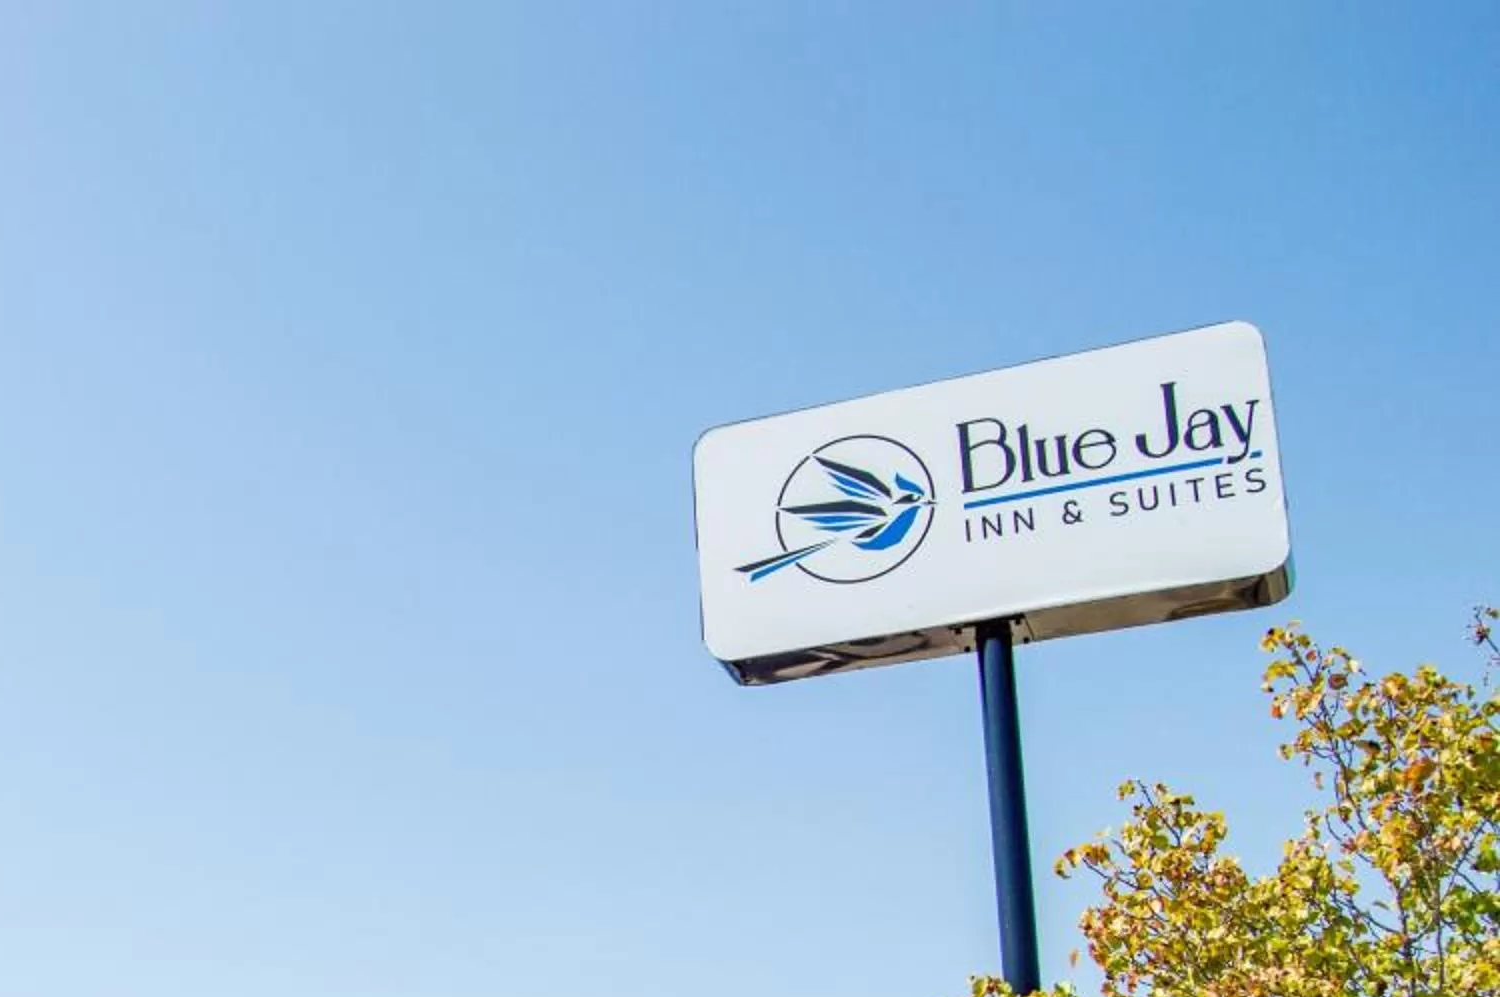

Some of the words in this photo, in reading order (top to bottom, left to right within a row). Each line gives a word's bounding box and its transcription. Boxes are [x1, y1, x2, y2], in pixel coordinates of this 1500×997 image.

[956, 417, 1118, 494] Blue
[1135, 381, 1260, 465] Jay
[965, 507, 1035, 543] INN
[1062, 499, 1083, 525] &
[1108, 467, 1267, 517] SUITES
